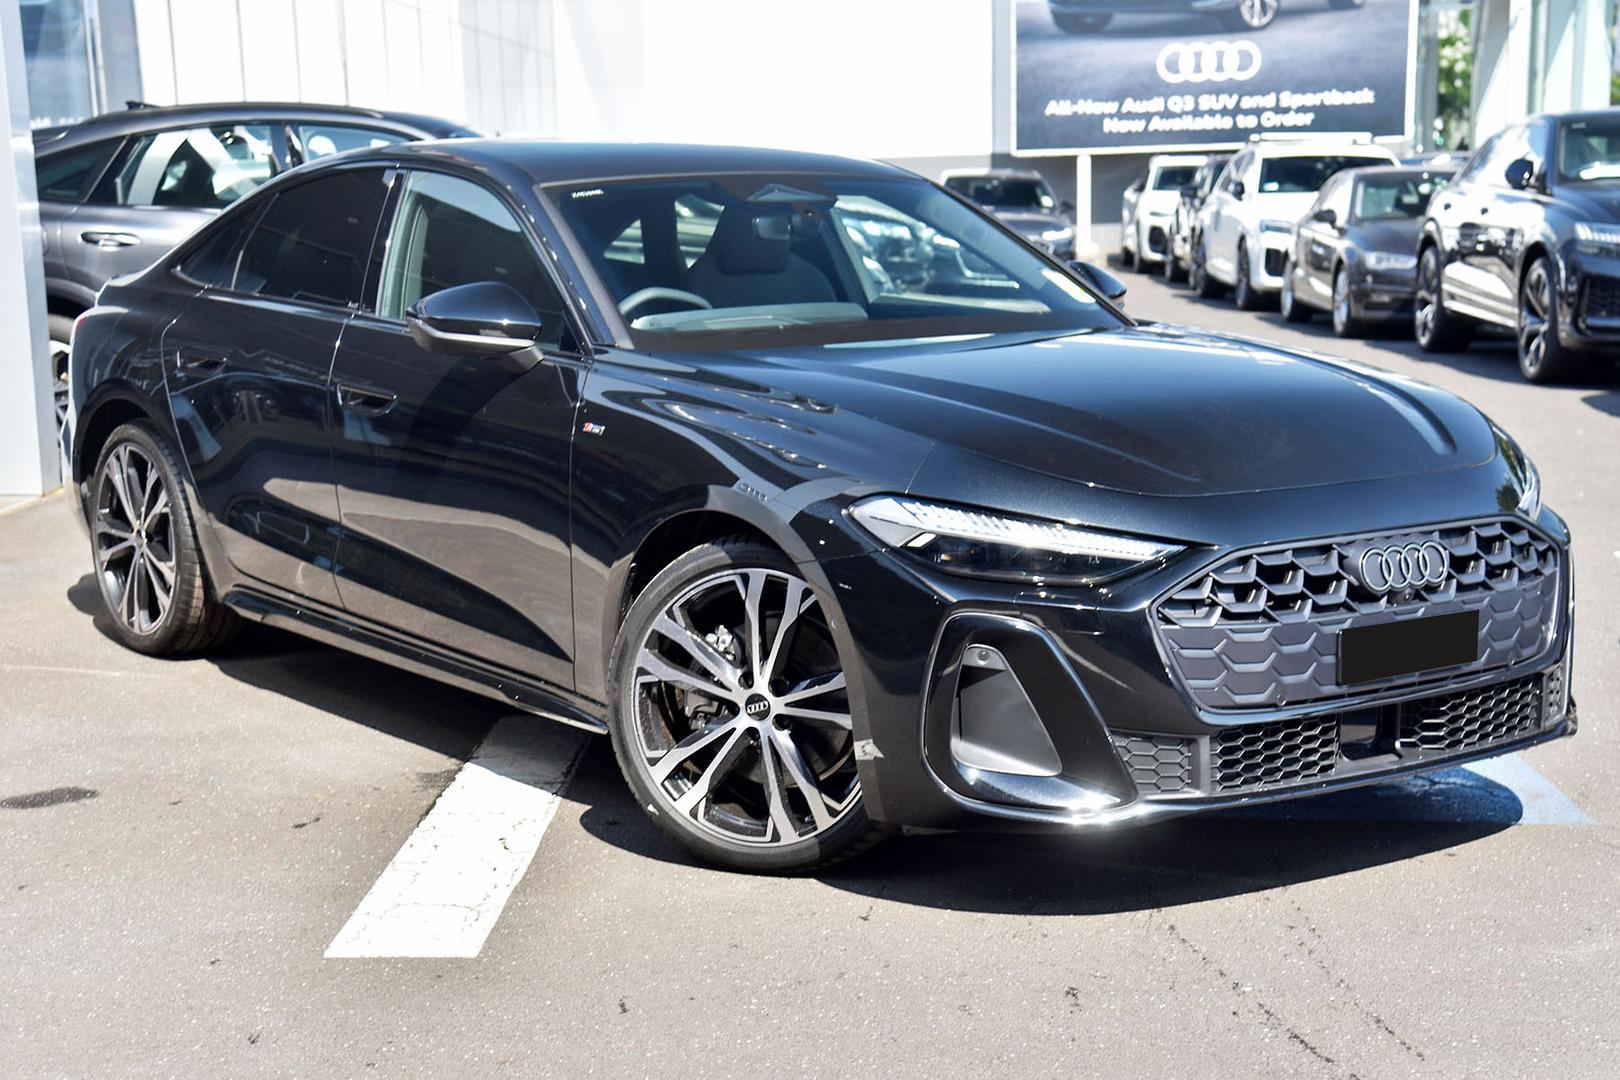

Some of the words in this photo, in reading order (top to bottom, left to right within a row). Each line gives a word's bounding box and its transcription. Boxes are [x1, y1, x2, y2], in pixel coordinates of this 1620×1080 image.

[1045, 99, 1119, 116] All-New
[1121, 97, 1165, 113] Audi
[1167, 95, 1195, 113] Q3
[1198, 93, 1239, 111] SUV
[1240, 92, 1277, 109] and
[1279, 87, 1375, 109] Sportback
[1147, 114, 1234, 132] Available
[1235, 114, 1259, 129] to
[1260, 110, 1315, 128] Order
